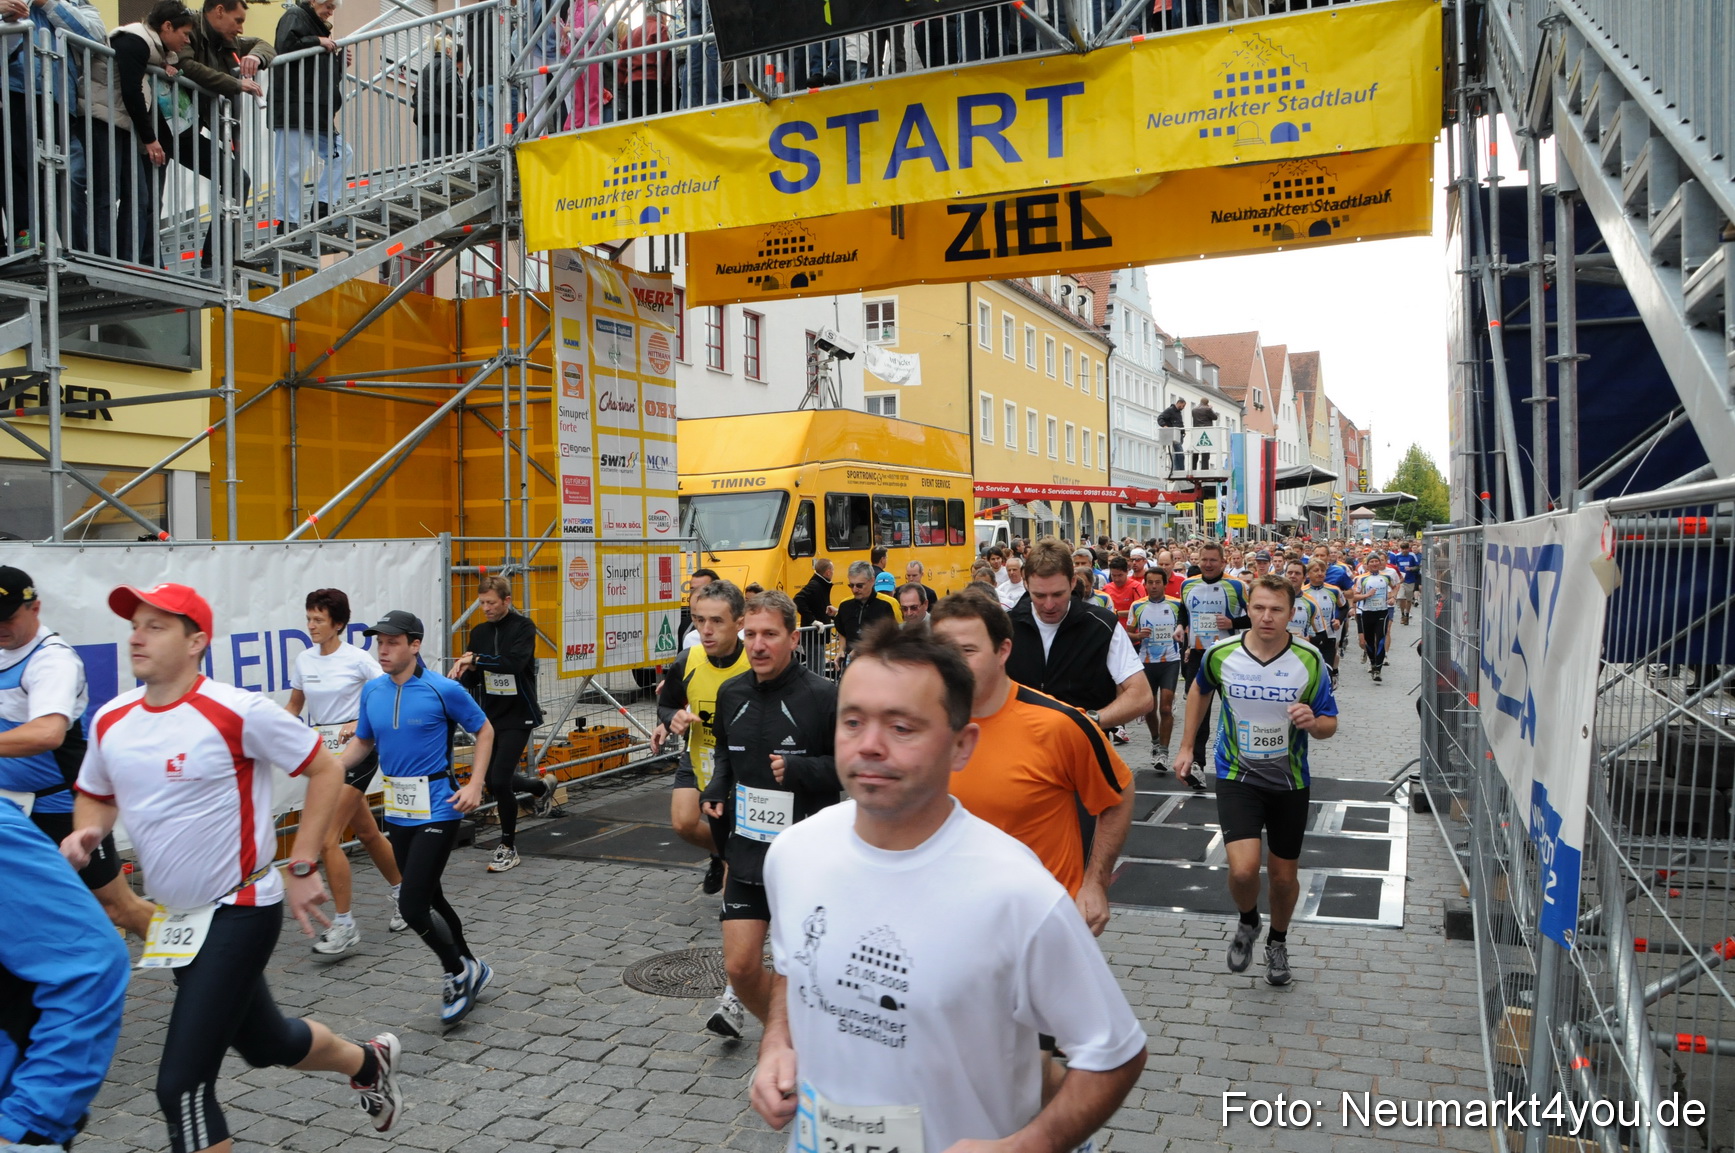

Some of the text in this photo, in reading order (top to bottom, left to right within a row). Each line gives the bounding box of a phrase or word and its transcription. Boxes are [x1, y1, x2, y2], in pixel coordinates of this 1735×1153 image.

[1146, 82, 1380, 131] Neumarkter Stadtlauf
[768, 81, 1085, 195] START
[555, 174, 721, 213] Neumarkter Stadtlauf
[1210, 188, 1393, 226] Neumarkter Stadtlauf
[945, 190, 1113, 262] ZIEL
[715, 248, 859, 277] Neumarkter Stadtlauf
[633, 287, 674, 307] MERZ
[564, 338, 580, 348] KANN
[648, 351, 671, 360] WITTMANN
[559, 405, 590, 421] Sinupret
[645, 400, 677, 419] OBI
[559, 420, 578, 432] forte
[569, 444, 591, 454] Egner
[647, 455, 669, 470] MCM
[847, 470, 878, 481] SPORTRONIC
[711, 477, 767, 489] TIMING
[921, 478, 951, 489] EVENT SERVICE
[1048, 488, 1083, 496] Serviceline:
[563, 525, 594, 534] HACKNER
[628, 520, 642, 529] BÖGL
[606, 565, 640, 581] Sinupret
[607, 582, 627, 596] forte
[616, 630, 642, 642] Egner
[1155, 632, 1172, 640] 3228
[566, 643, 595, 655] MERZ
[494, 679, 510, 687] 898
[1229, 684, 1299, 703] BOCK
[1252, 725, 1282, 734] Christian
[1253, 735, 1284, 747] 2688
[396, 794, 417, 806] 697
[748, 792, 769, 804] Peter
[749, 808, 786, 825] 2422
[161, 927, 194, 946] 392
[844, 963, 910, 993] 21.09.2008
[818, 997, 908, 1034] Neumarkter
[837, 1017, 908, 1049] Stadtlauf
[819, 1105, 885, 1135] Manfred
